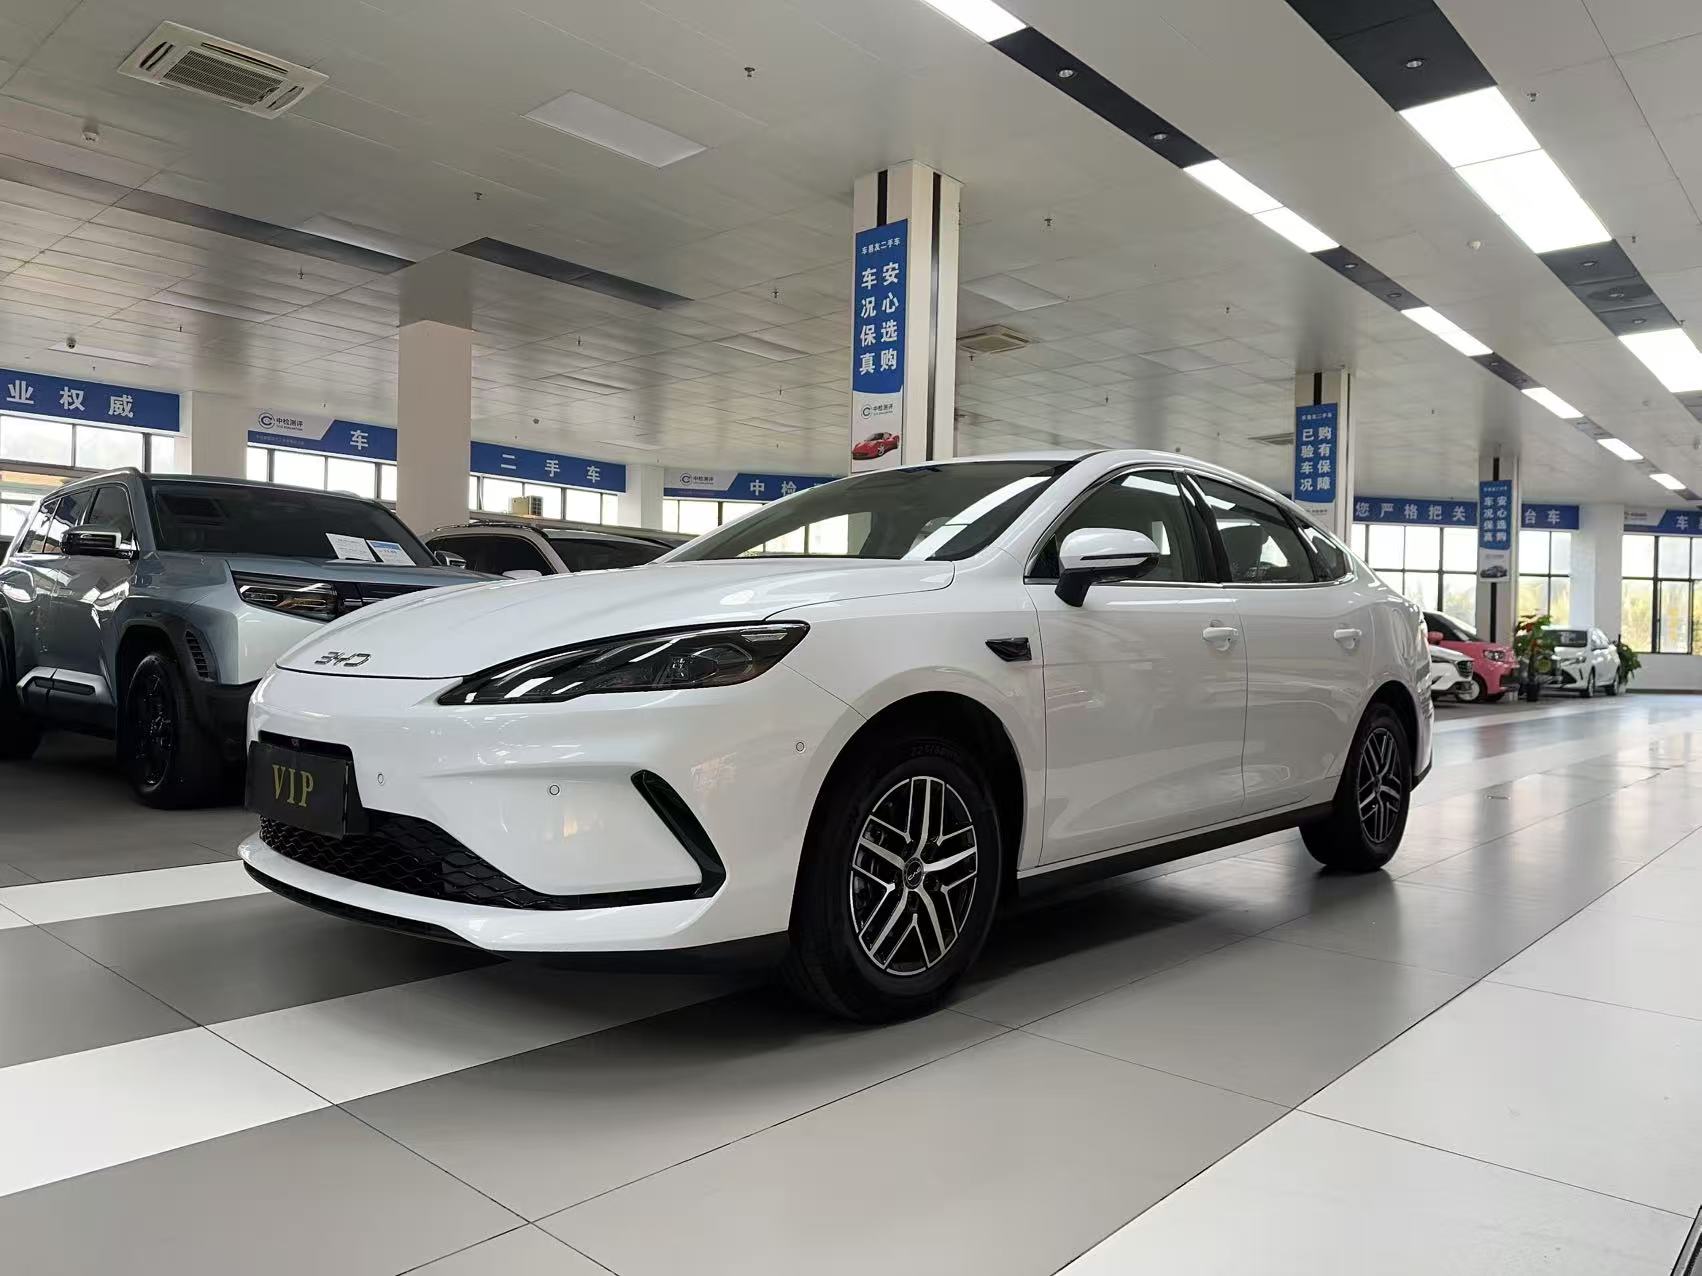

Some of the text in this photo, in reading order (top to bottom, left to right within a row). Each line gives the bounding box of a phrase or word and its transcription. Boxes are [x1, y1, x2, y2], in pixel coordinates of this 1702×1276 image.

[859, 266, 877, 376] 车况保真
[880, 262, 899, 372] 安心选购
[6, 379, 134, 418] 业权威
[350, 430, 600, 483] 车 二手车
[1301, 428, 1315, 491] 已验车况
[1317, 426, 1332, 491] 购有保障
[750, 479, 819, 497] 中检
[1356, 502, 1466, 521] 您严格把关
[314, 651, 371, 668] BYD
[272, 764, 314, 808] VIP
